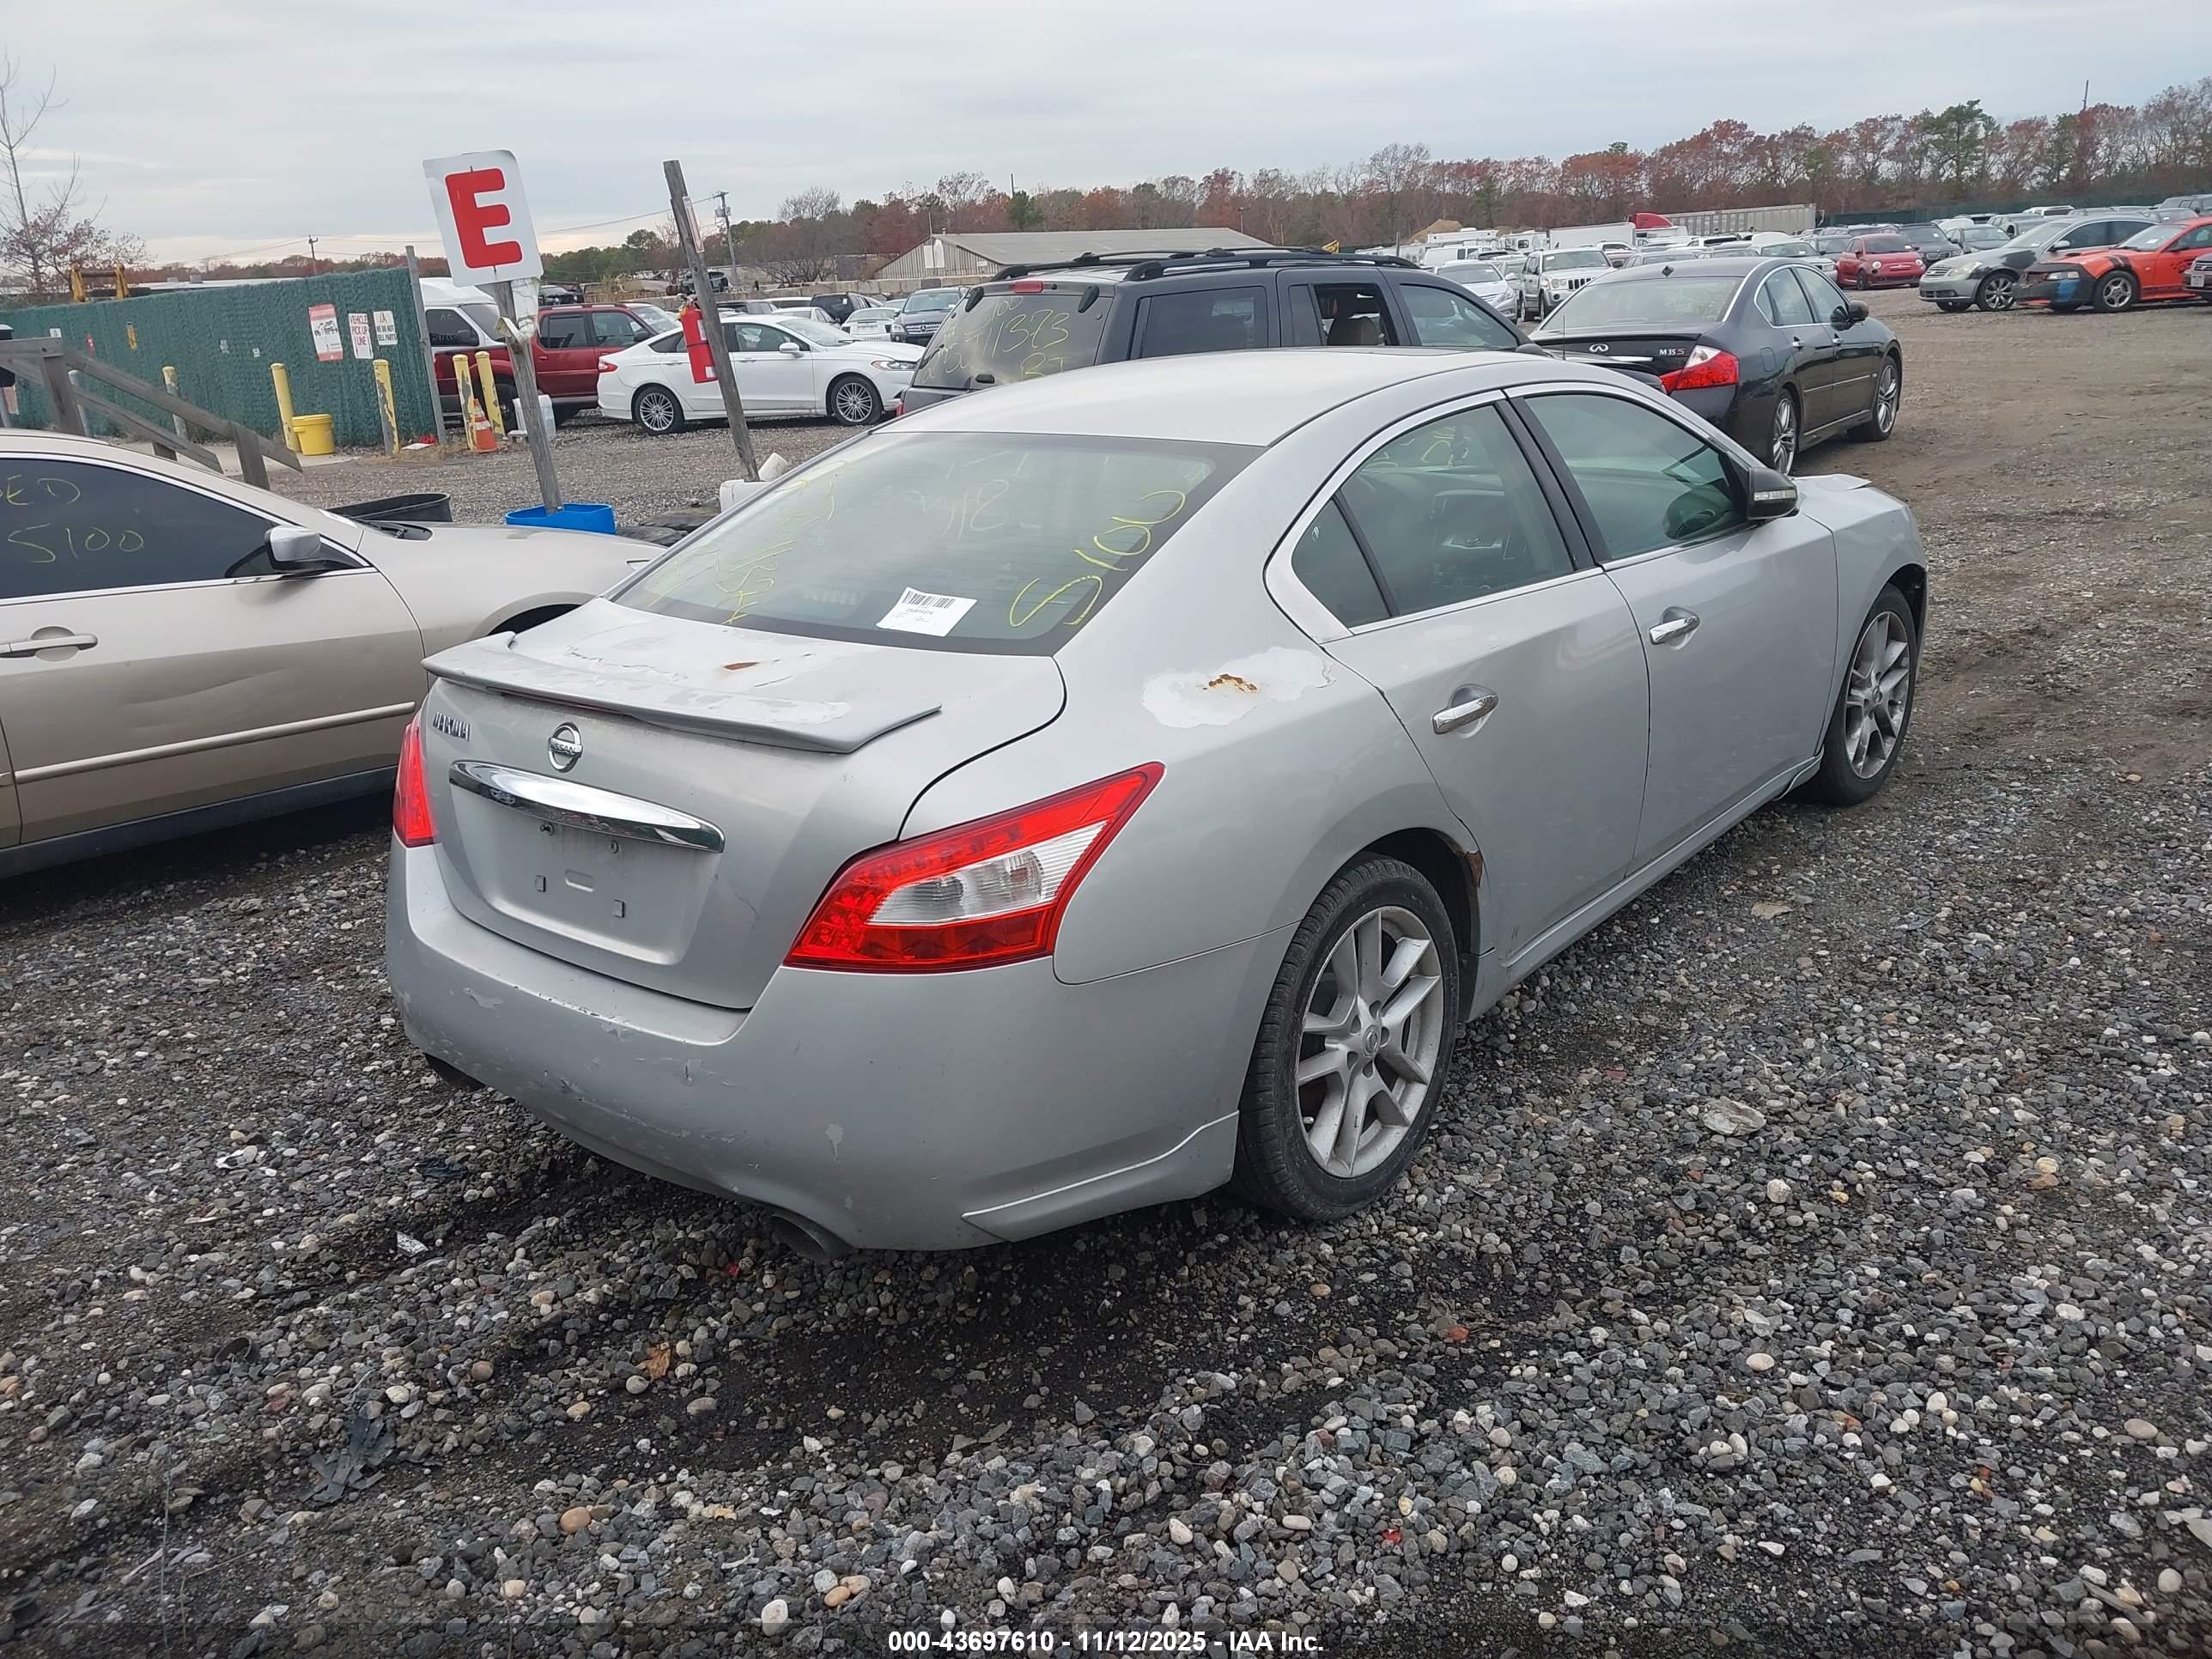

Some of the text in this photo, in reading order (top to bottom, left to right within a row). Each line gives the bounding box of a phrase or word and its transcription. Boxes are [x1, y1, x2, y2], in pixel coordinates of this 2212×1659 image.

[447, 169, 521, 268] E
[349, 315, 368, 325] VEHICLE
[351, 325, 368, 335] PICK UP
[356, 336, 368, 345] LINE
[0, 474, 81, 506] ED
